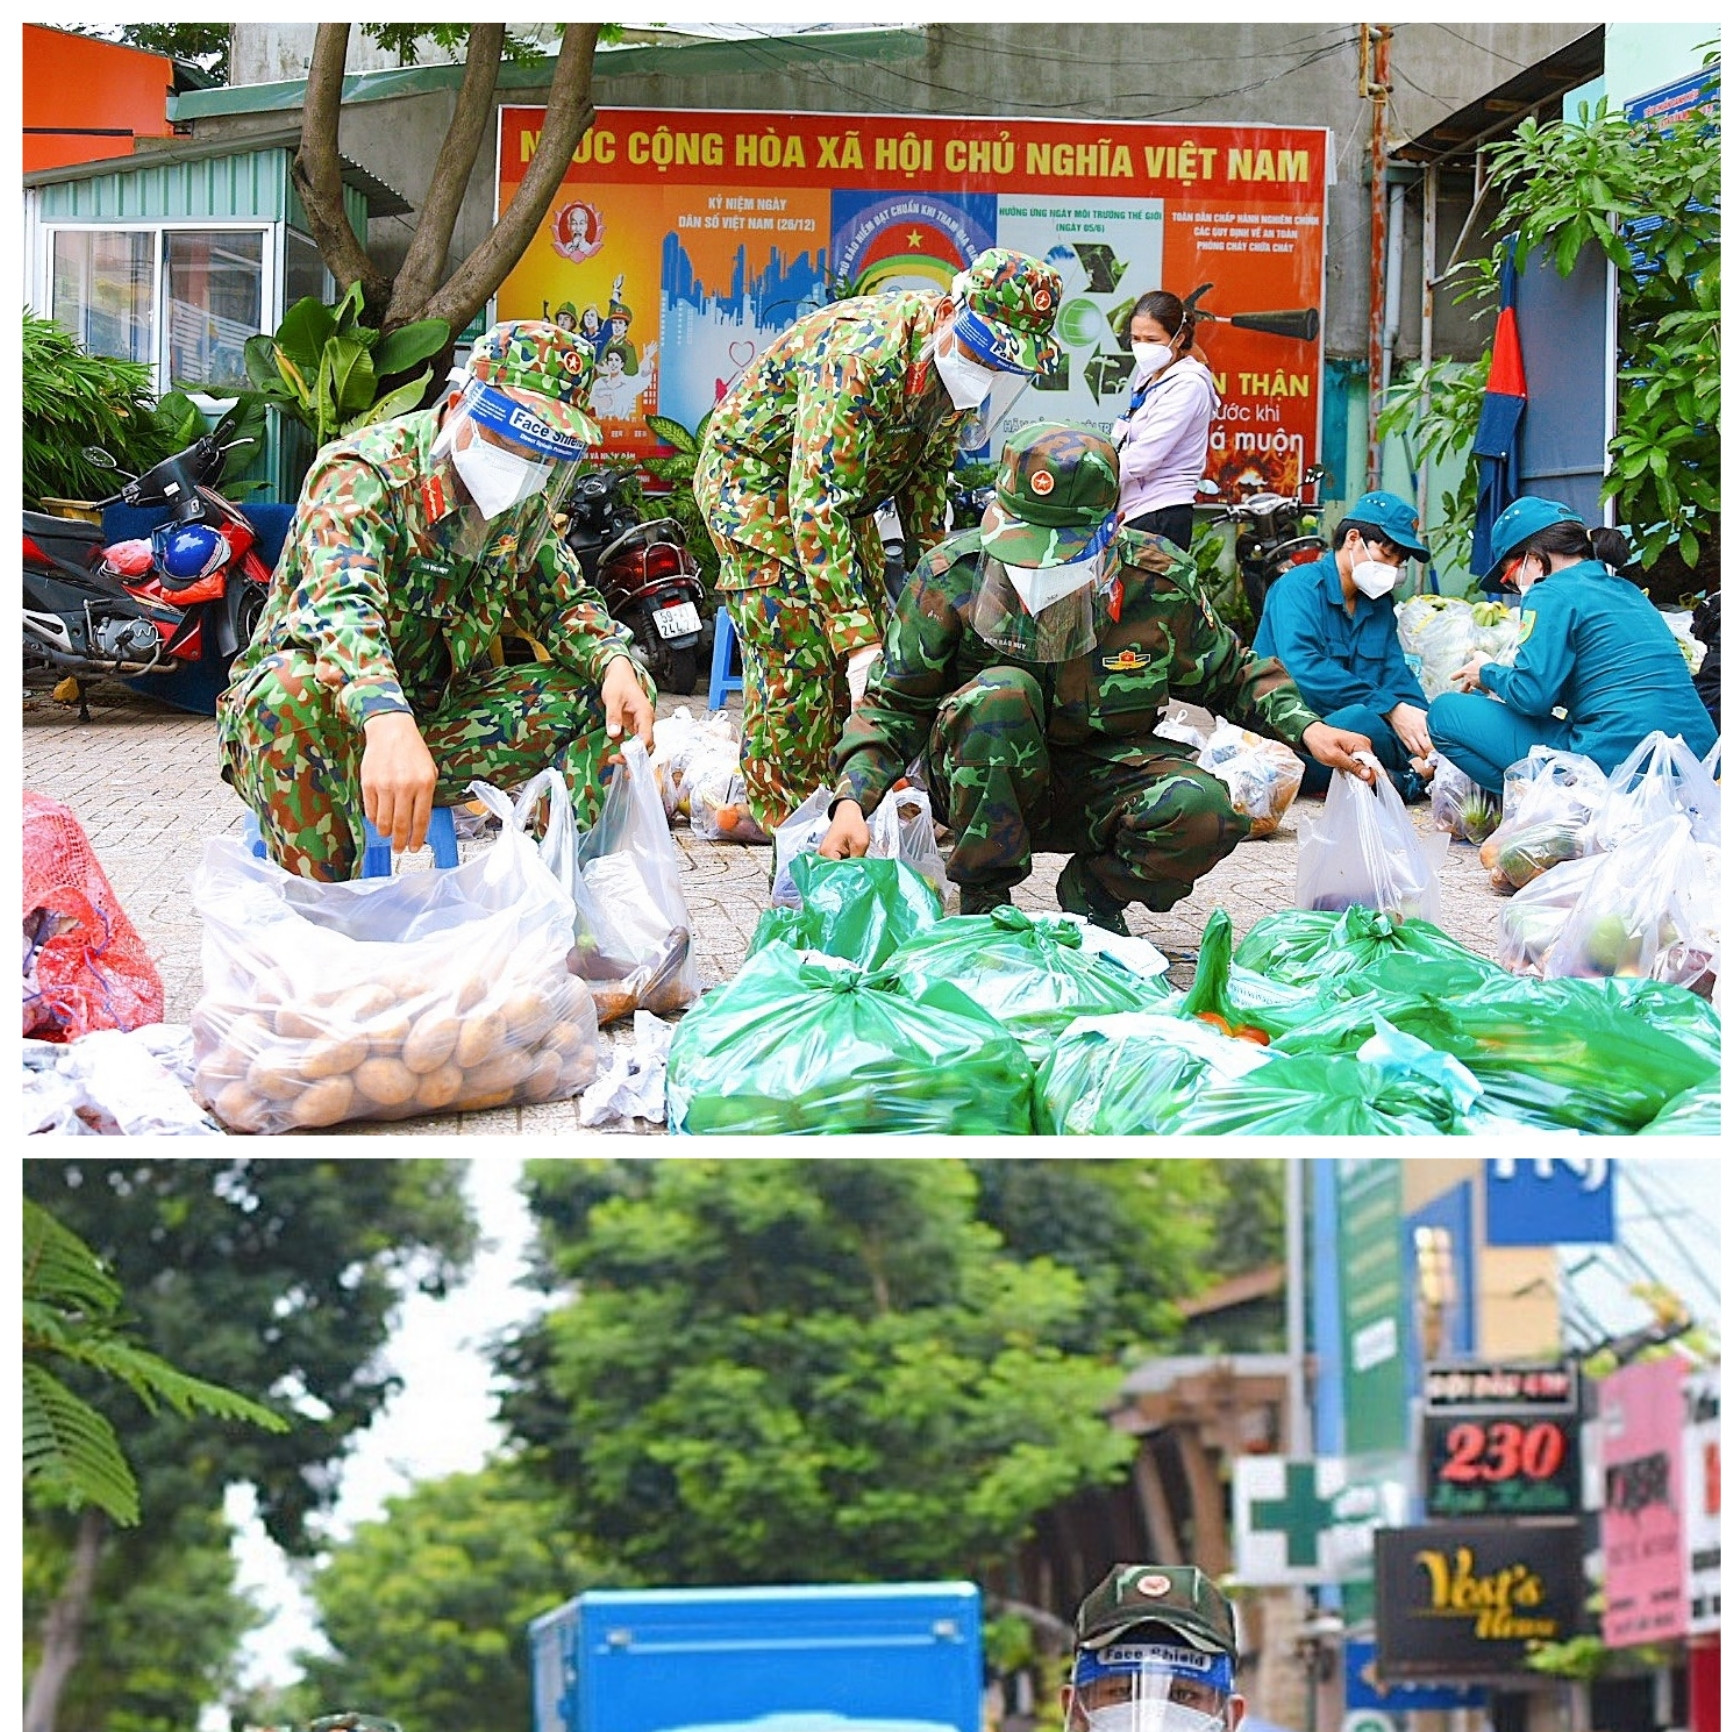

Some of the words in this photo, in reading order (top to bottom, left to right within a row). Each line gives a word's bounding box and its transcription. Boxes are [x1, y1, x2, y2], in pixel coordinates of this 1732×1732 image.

[628, 125, 723, 172] CỘNG
[735, 126, 806, 168] HÒA
[816, 130, 864, 169] XÃ
[875, 131, 933, 178] HỘI
[945, 130, 1014, 174] CHỦ
[1026, 138, 1134, 178] NGHĨA
[1144, 139, 1217, 187] VIỆT
[1228, 148, 1309, 183] NAM
[725, 197, 755, 213] NIỆM
[757, 198, 787, 211] NGÀY
[920, 204, 936, 217] KHI
[1050, 207, 1072, 218] NGÀY
[678, 214, 701, 228] DÂN
[705, 213, 719, 228] SỐ
[722, 216, 746, 232] VIỆT
[749, 217, 774, 230] NAM
[1056, 223, 1081, 233] (NGÀY
[1238, 368, 1309, 401] THẬN
[1216, 403, 1251, 421] ước
[1256, 404, 1280, 422] khi
[514, 411, 549, 437] Face
[1235, 427, 1304, 457] muộn
[1440, 1421, 1564, 1481] 230
